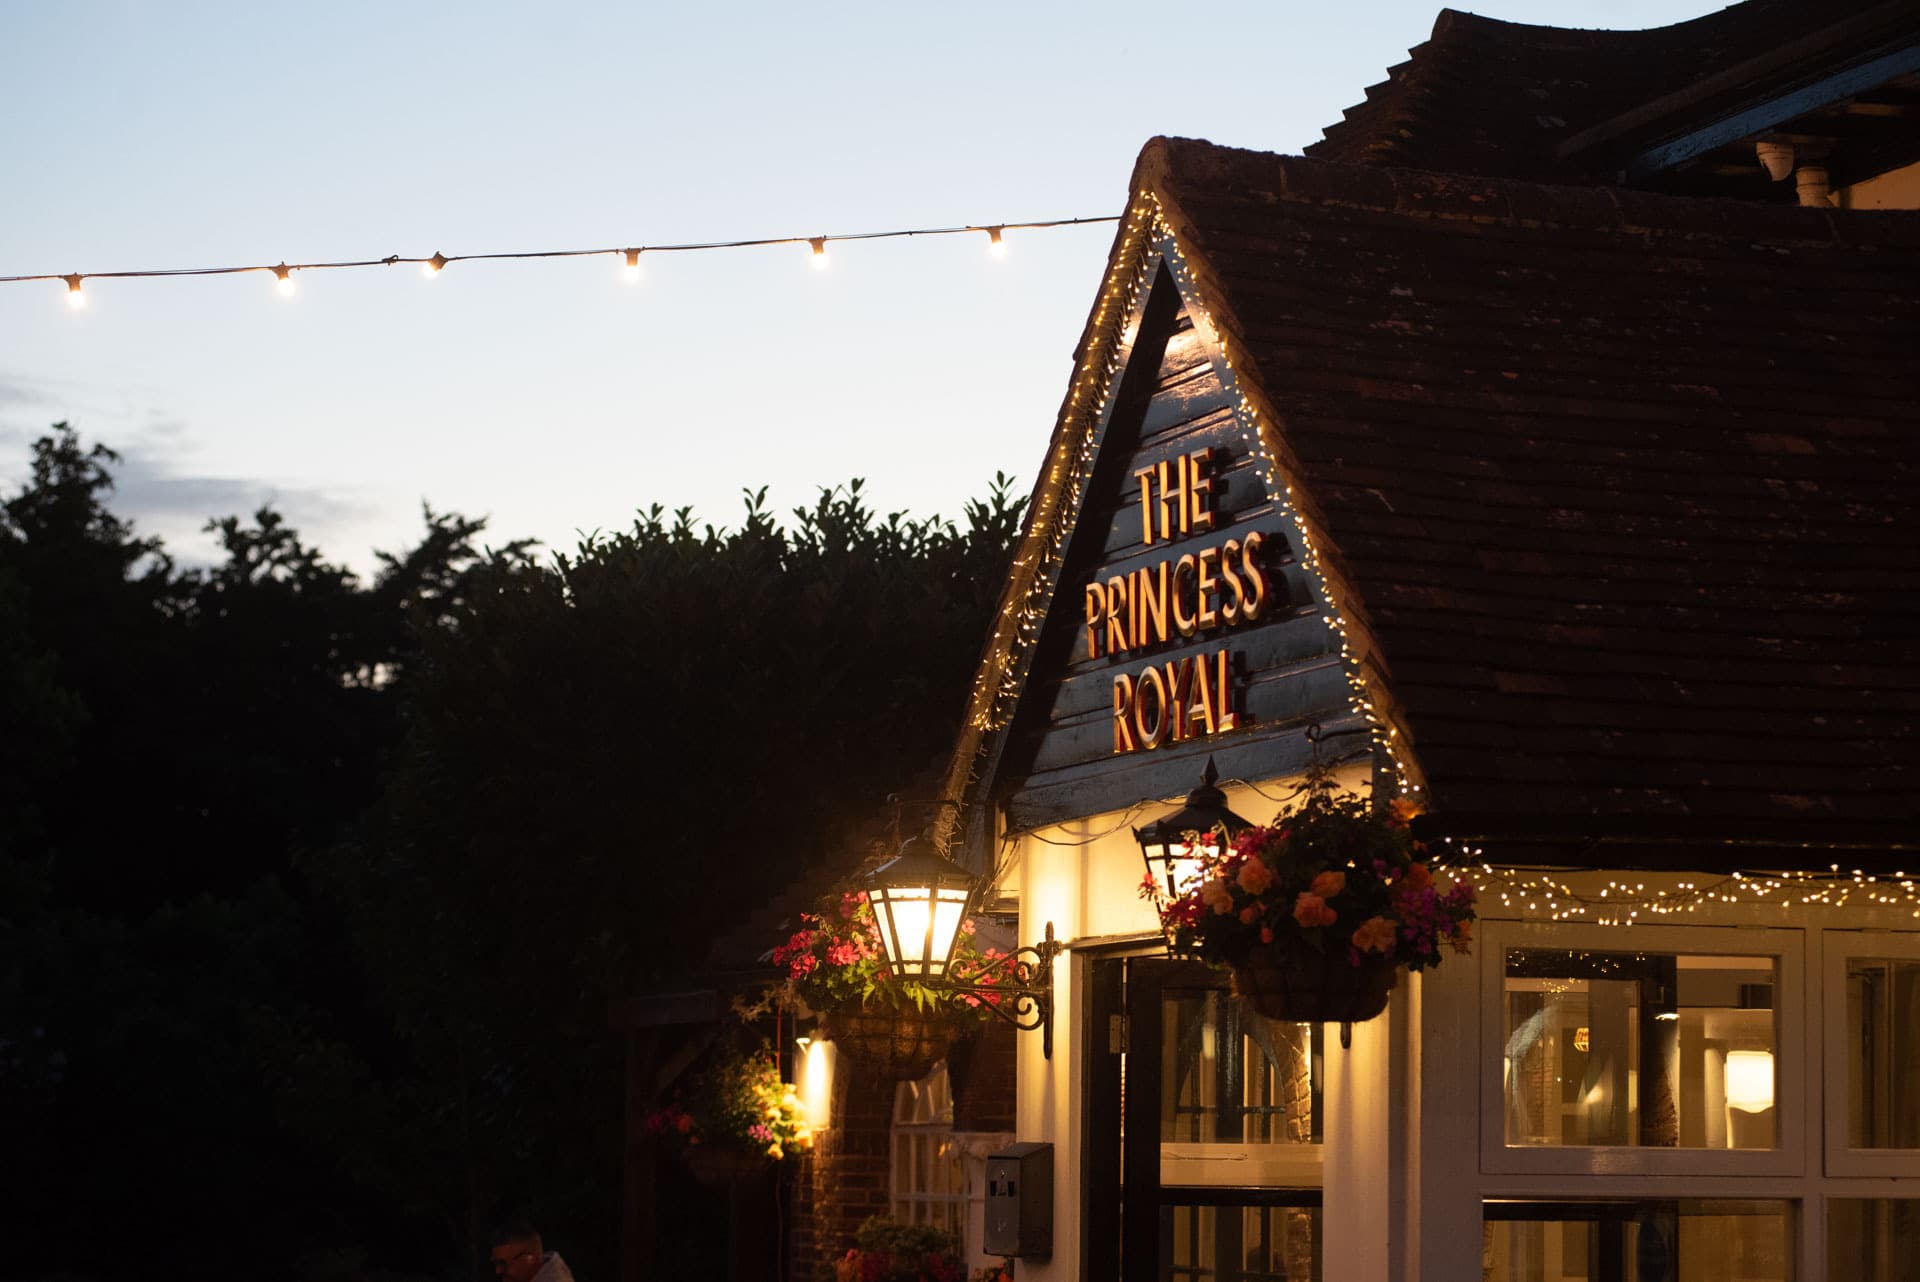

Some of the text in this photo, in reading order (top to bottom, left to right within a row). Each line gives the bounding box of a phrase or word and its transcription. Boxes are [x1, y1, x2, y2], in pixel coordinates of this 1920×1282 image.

[1134, 447, 1214, 544] THE
[1086, 531, 1265, 660] PRINCESS
[1113, 650, 1238, 753] ROYAL
